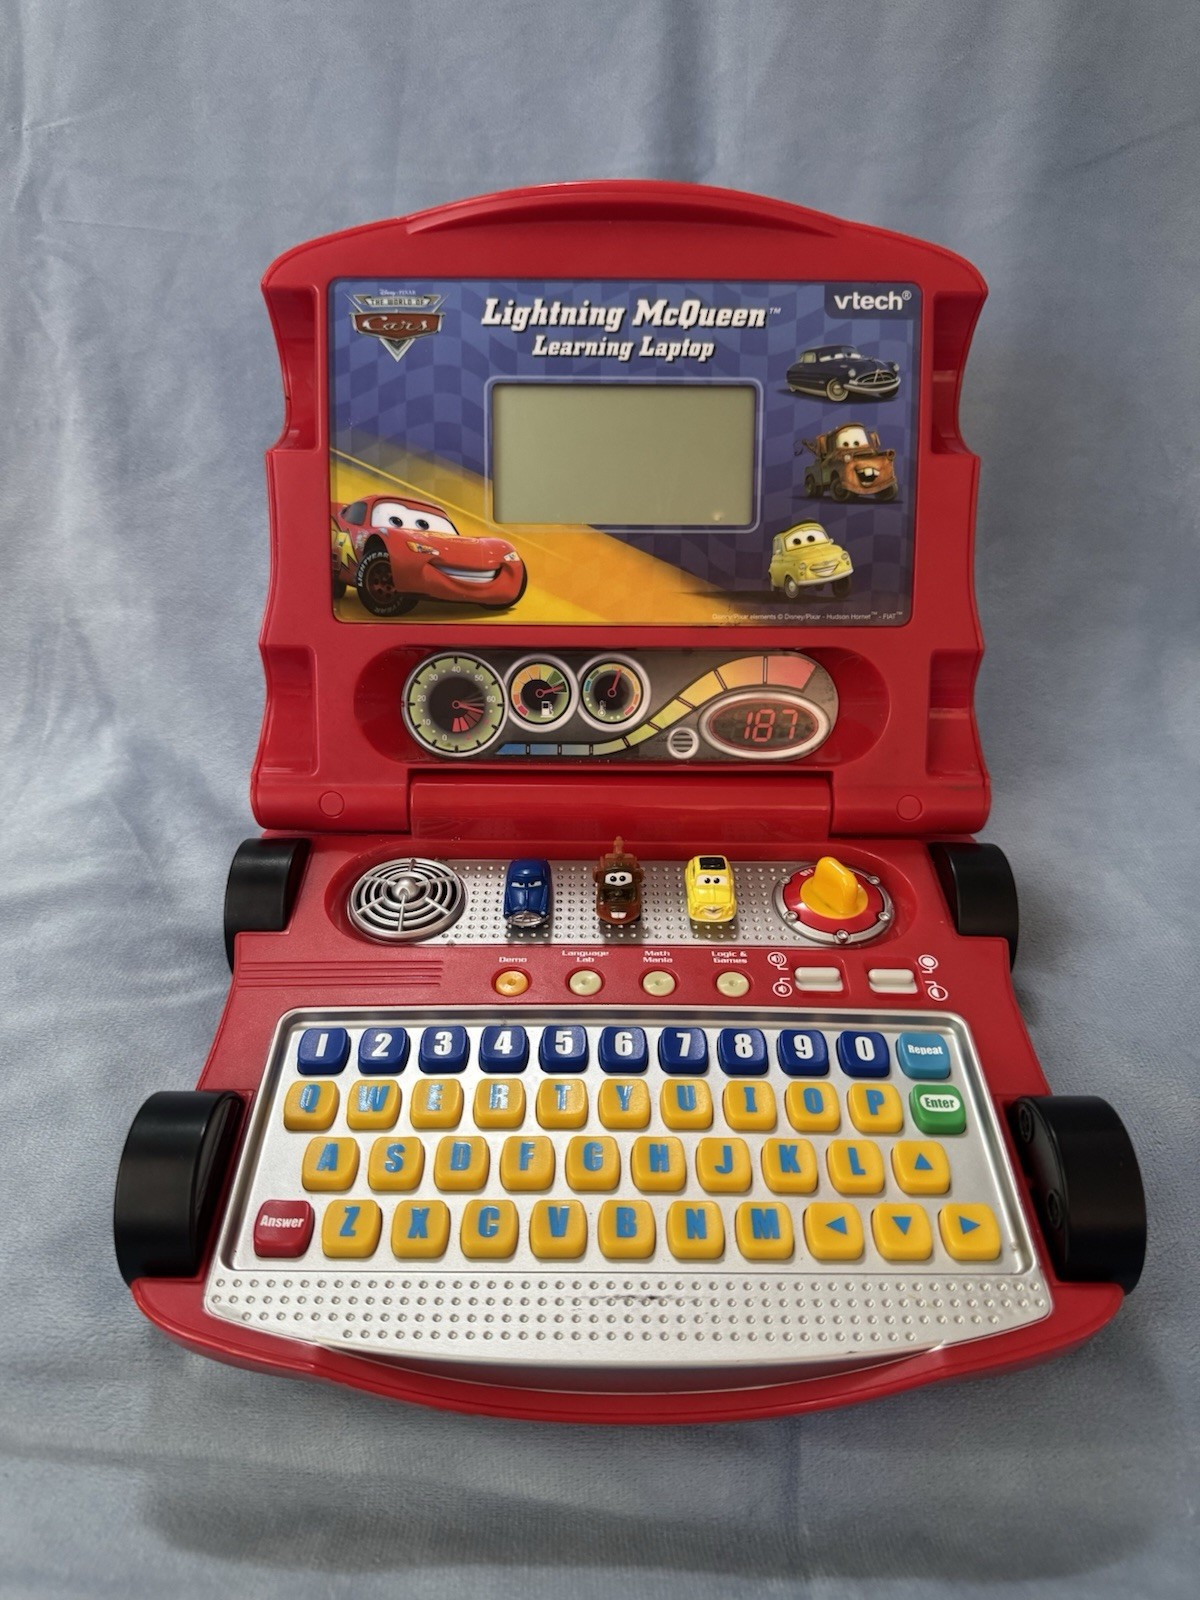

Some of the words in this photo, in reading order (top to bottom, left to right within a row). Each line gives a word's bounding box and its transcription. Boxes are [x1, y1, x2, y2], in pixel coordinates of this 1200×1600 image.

[362, 316, 430, 331] Cars
[481, 298, 626, 331] Lightning
[532, 334, 634, 362] Learning
[638, 336, 714, 362] Laptop
[357, 552, 389, 587] LIGHTYEAR
[474, 674, 484, 682] 50
[744, 709, 798, 742] 187
[316, 1033, 328, 1056] 1
[372, 1033, 392, 1056] 2
[434, 1031, 452, 1055] 3
[494, 1031, 512, 1054] 4
[555, 1031, 573, 1055] 5
[615, 1032, 632, 1056] 6
[676, 1033, 691, 1056] 7
[734, 1033, 753, 1058] 8
[793, 1034, 814, 1059] 9
[855, 1036, 876, 1061] 0
[908, 1045, 943, 1056] Repeat
[300, 1084, 321, 1113] Q
[358, 1085, 390, 1112] W
[427, 1084, 442, 1111] E
[489, 1084, 508, 1110] R
[554, 1084, 571, 1110] T
[616, 1086, 632, 1111] Y
[676, 1086, 697, 1111] U
[745, 1087, 757, 1113] I
[804, 1088, 823, 1114] O
[868, 1090, 884, 1115] P
[924, 1098, 955, 1109] Enter
[316, 1143, 339, 1171] A
[385, 1143, 405, 1172] S
[450, 1142, 472, 1171] D
[519, 1142, 535, 1170] F
[584, 1142, 603, 1171] G
[650, 1144, 669, 1172] H
[714, 1146, 731, 1174] J
[779, 1145, 802, 1173] K
[848, 1147, 866, 1175] L
[260, 1214, 304, 1229] Answer
[339, 1206, 360, 1236] Z
[407, 1207, 430, 1239] X
[478, 1206, 500, 1238] C
[547, 1206, 570, 1237] V
[616, 1207, 637, 1238] B
[686, 1209, 707, 1239] N
[751, 1209, 780, 1239] M
